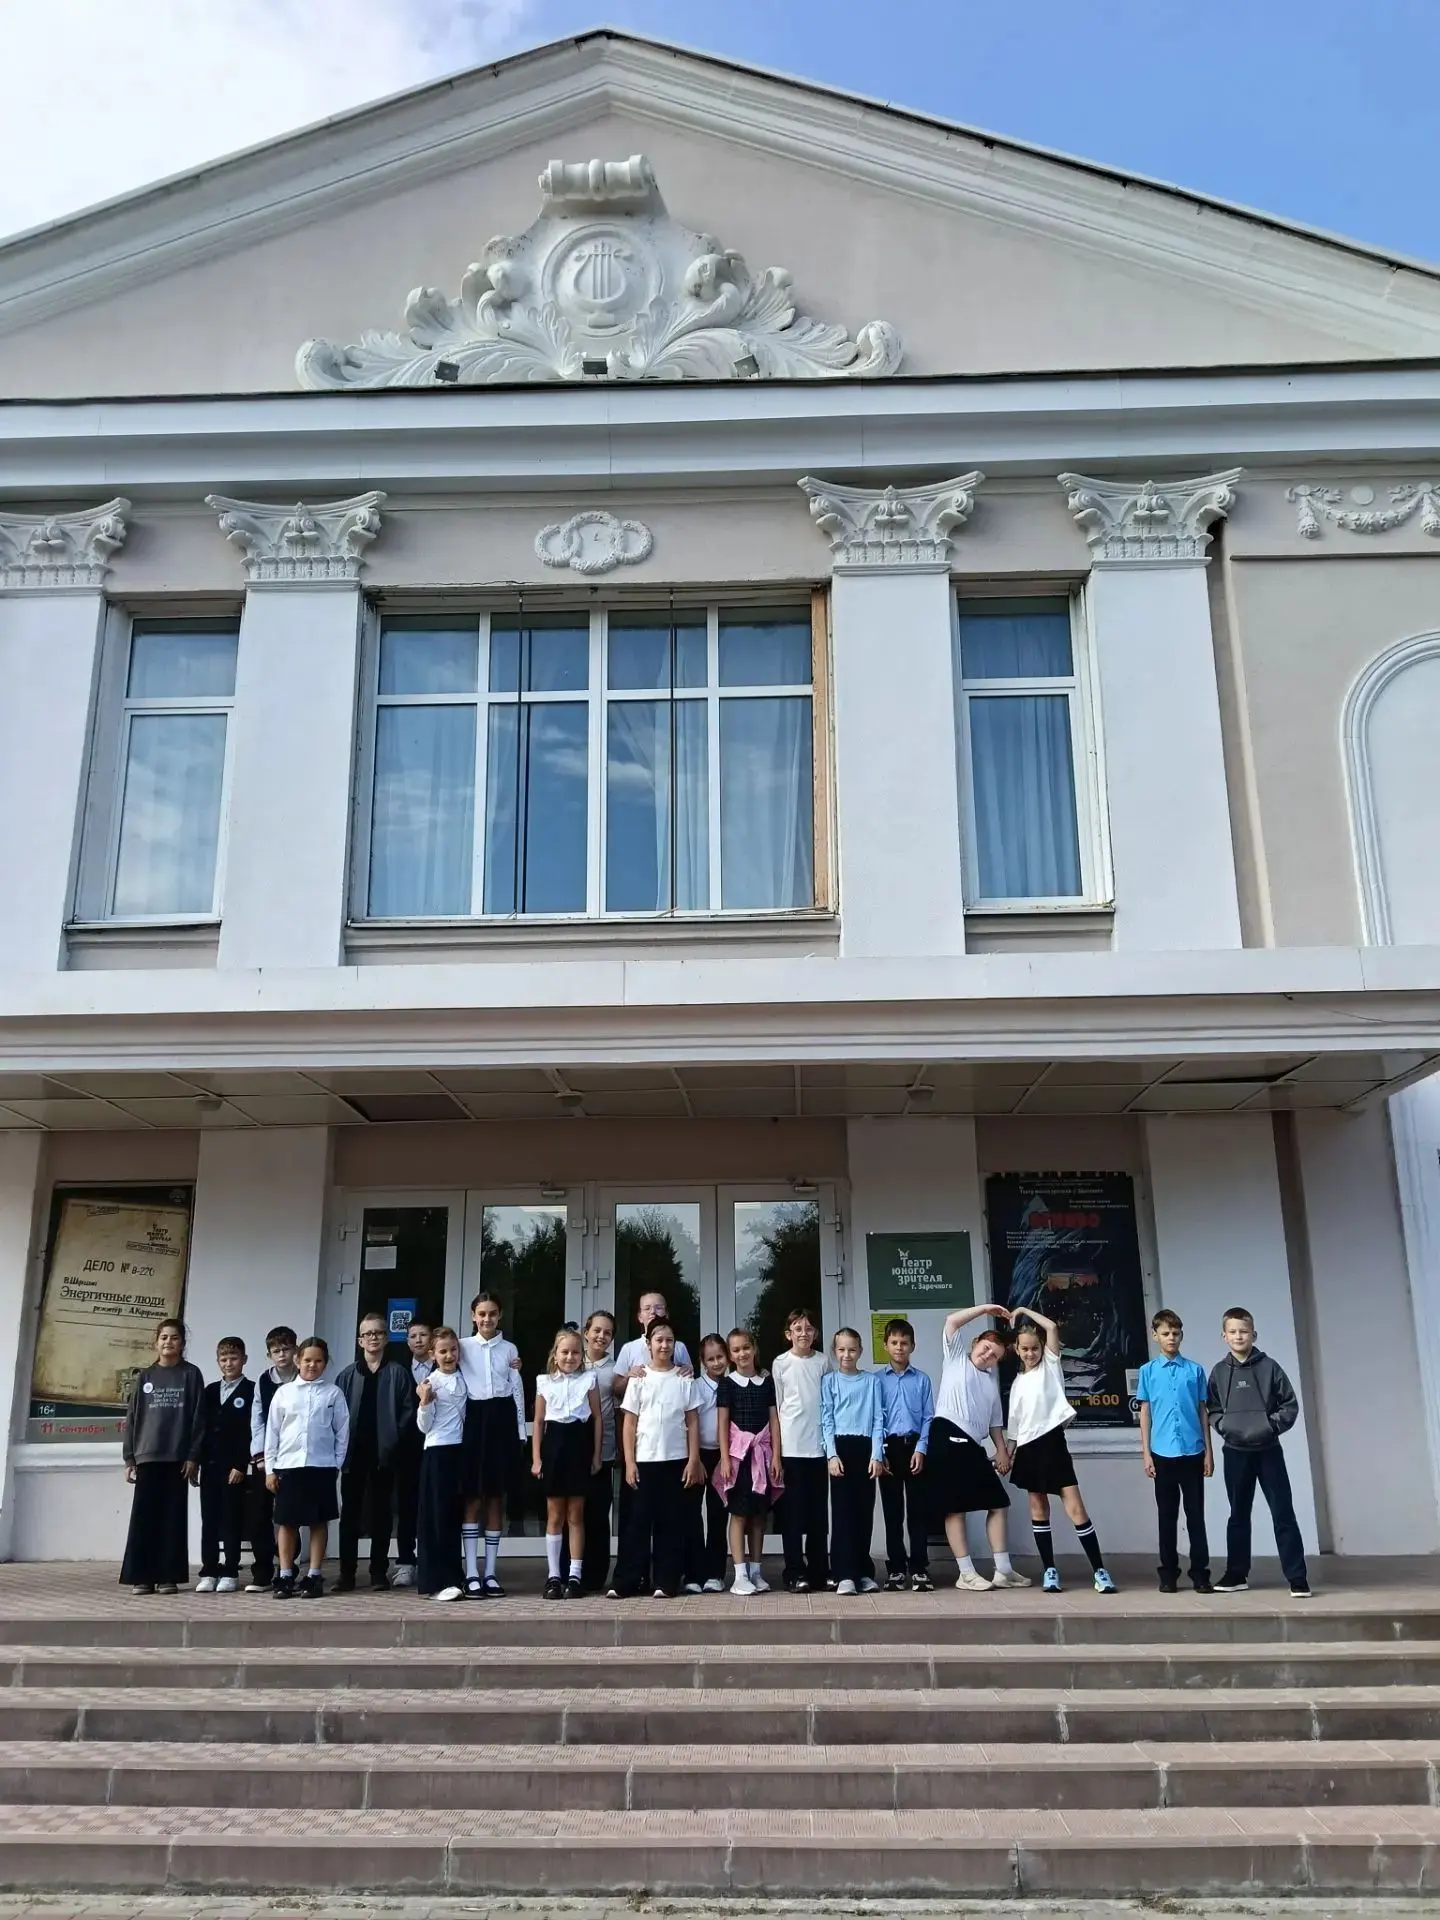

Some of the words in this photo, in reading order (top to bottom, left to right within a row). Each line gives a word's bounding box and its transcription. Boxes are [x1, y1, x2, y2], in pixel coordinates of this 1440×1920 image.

[83, 1260, 115, 1273] ДЕЛО
[120, 1262, 130, 1273] №
[900, 1257, 932, 1269] Театр
[892, 1267, 925, 1275] юного
[898, 1274, 943, 1285] зрителя
[918, 1283, 953, 1291] Заречного
[60, 1286, 132, 1302] Энергичные
[133, 1295, 165, 1307] люди
[39, 1405, 55, 1415] 16+
[41, 1422, 53, 1434] 11
